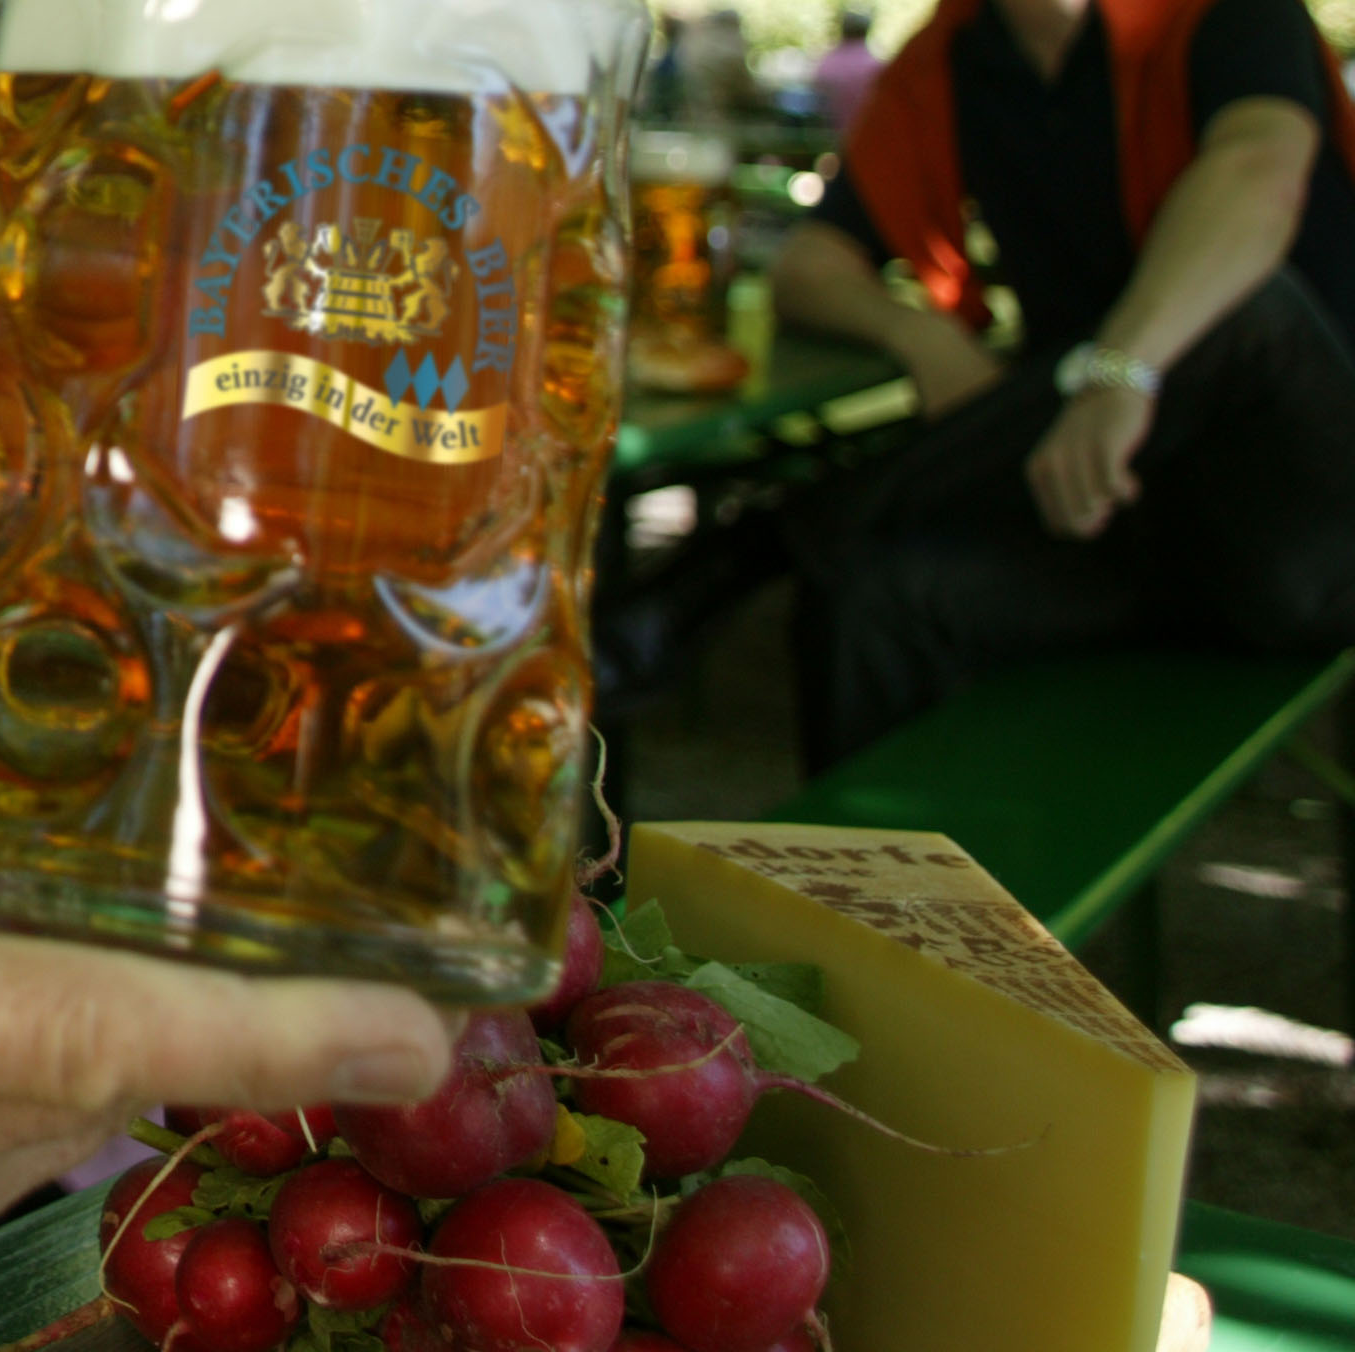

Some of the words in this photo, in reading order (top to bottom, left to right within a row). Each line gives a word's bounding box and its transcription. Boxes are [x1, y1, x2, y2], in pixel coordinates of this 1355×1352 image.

[190, 145, 481, 338] BAYERISCHES
[466, 238, 518, 373] BIER
[216, 363, 307, 400] einzig
[314, 377, 344, 409] in
[352, 387, 400, 436] der
[410, 419, 482, 449] Welt
